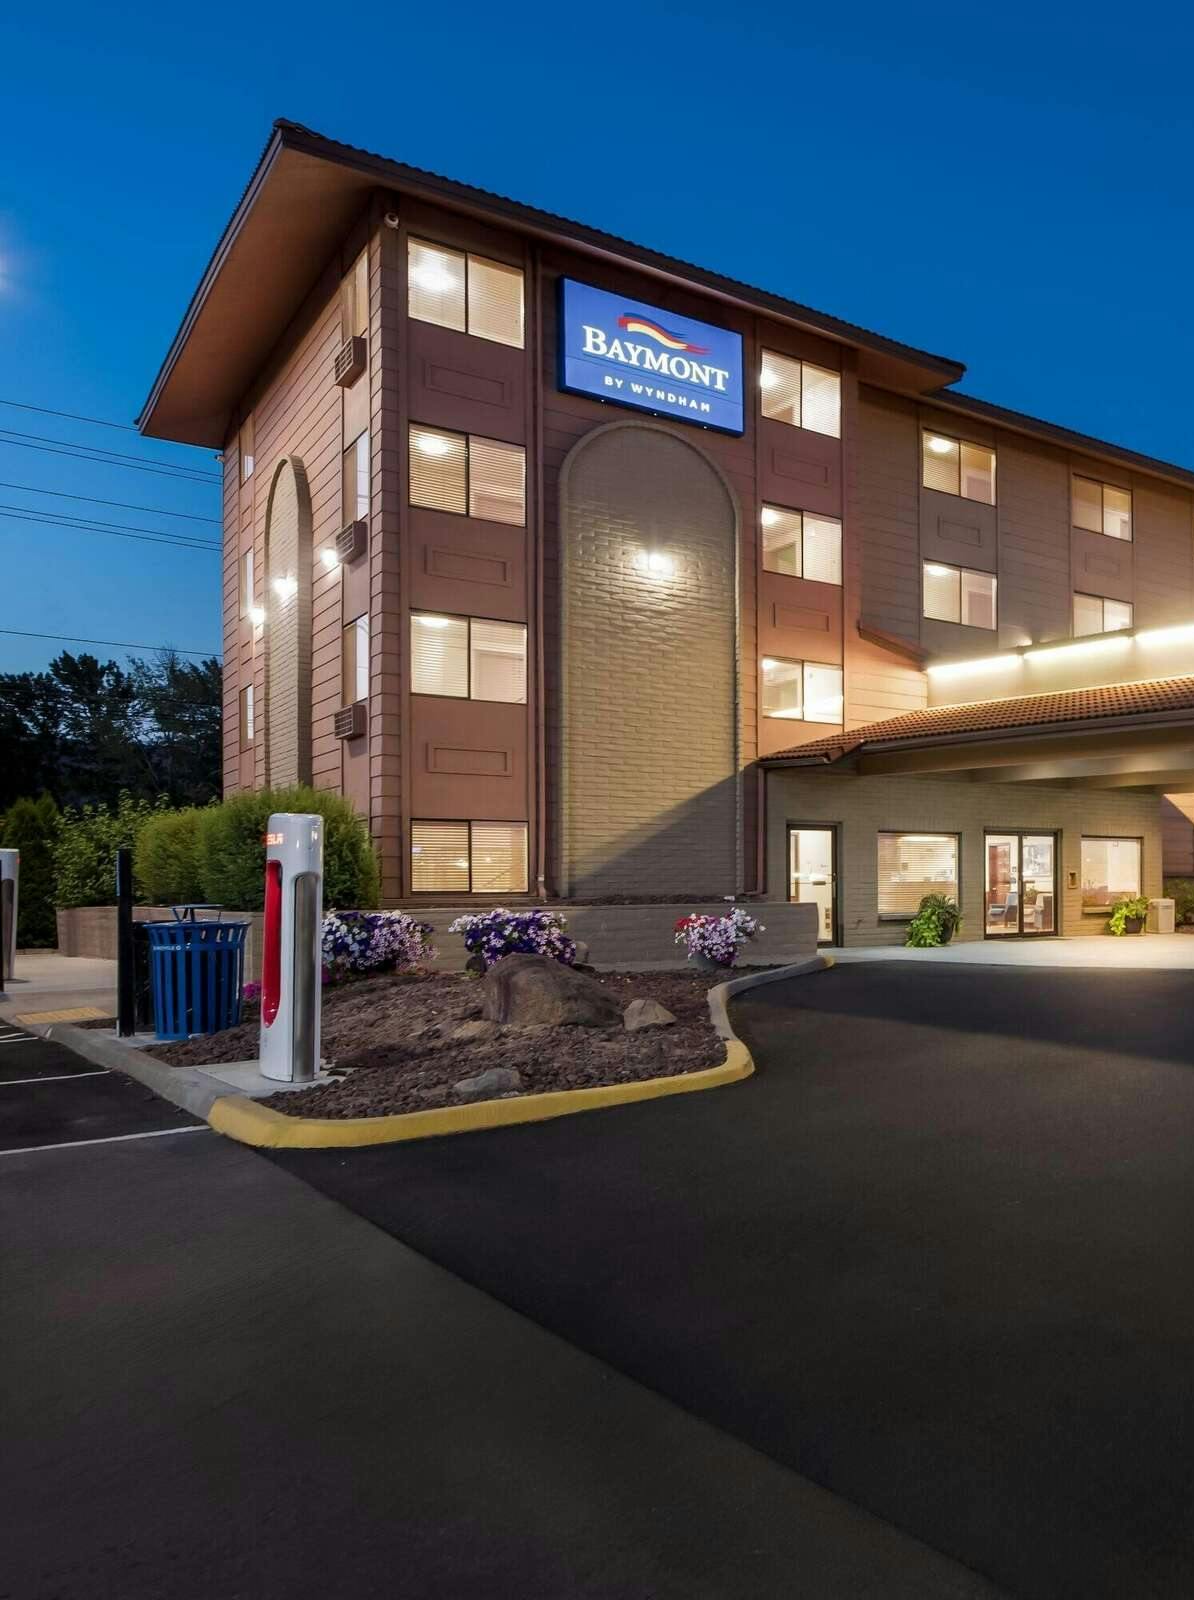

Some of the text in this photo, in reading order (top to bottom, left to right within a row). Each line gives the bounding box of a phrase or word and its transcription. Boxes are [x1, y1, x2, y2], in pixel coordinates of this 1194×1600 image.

[582, 325, 729, 391] BAYMONT
[604, 375, 710, 412] BY WYNDHAM
